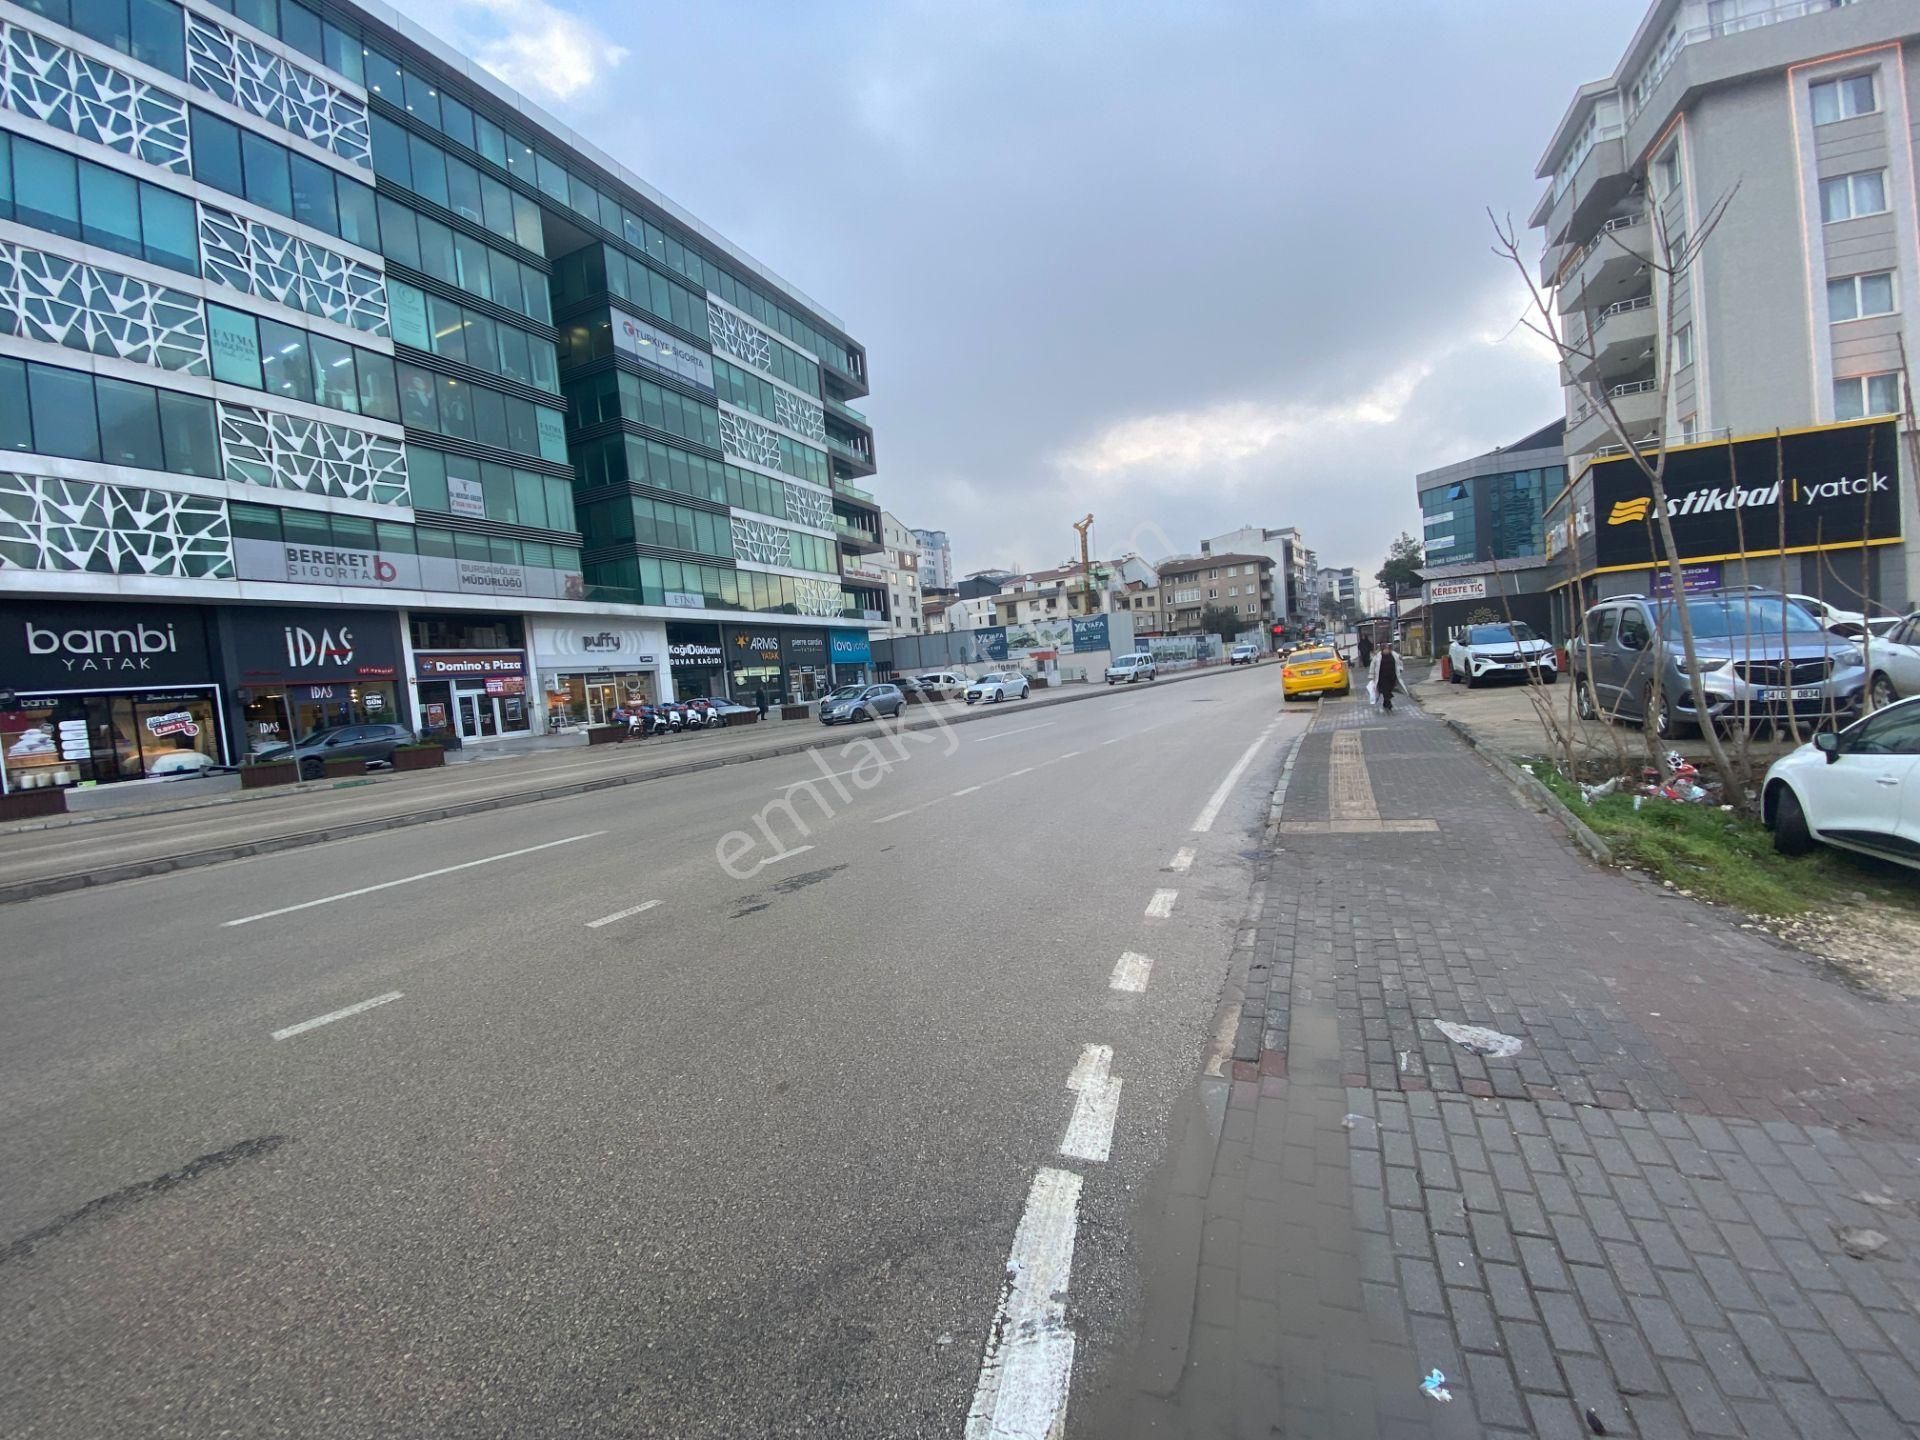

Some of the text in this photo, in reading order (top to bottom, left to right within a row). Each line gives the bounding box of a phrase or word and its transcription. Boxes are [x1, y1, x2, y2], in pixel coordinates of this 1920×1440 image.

[1803, 471, 1888, 505] yatak
[287, 548, 369, 567] BEREKET
[461, 563, 521, 577] BURSA BÖLGE
[461, 574, 522, 588] MÜDÜRLÜĞÜ
[1432, 585, 1467, 597] KERESTE
[26, 622, 177, 655] bambi
[582, 632, 621, 651] puffy
[791, 638, 823, 647] pierre cardin
[833, 637, 853, 652] lova
[669, 656, 722, 666] DUVAR KAĞIDI
[760, 651, 780, 660] YATAK
[62, 657, 151, 672] YATAK
[435, 660, 522, 672] Domino's Pizza
[20, 697, 59, 707] bambi
